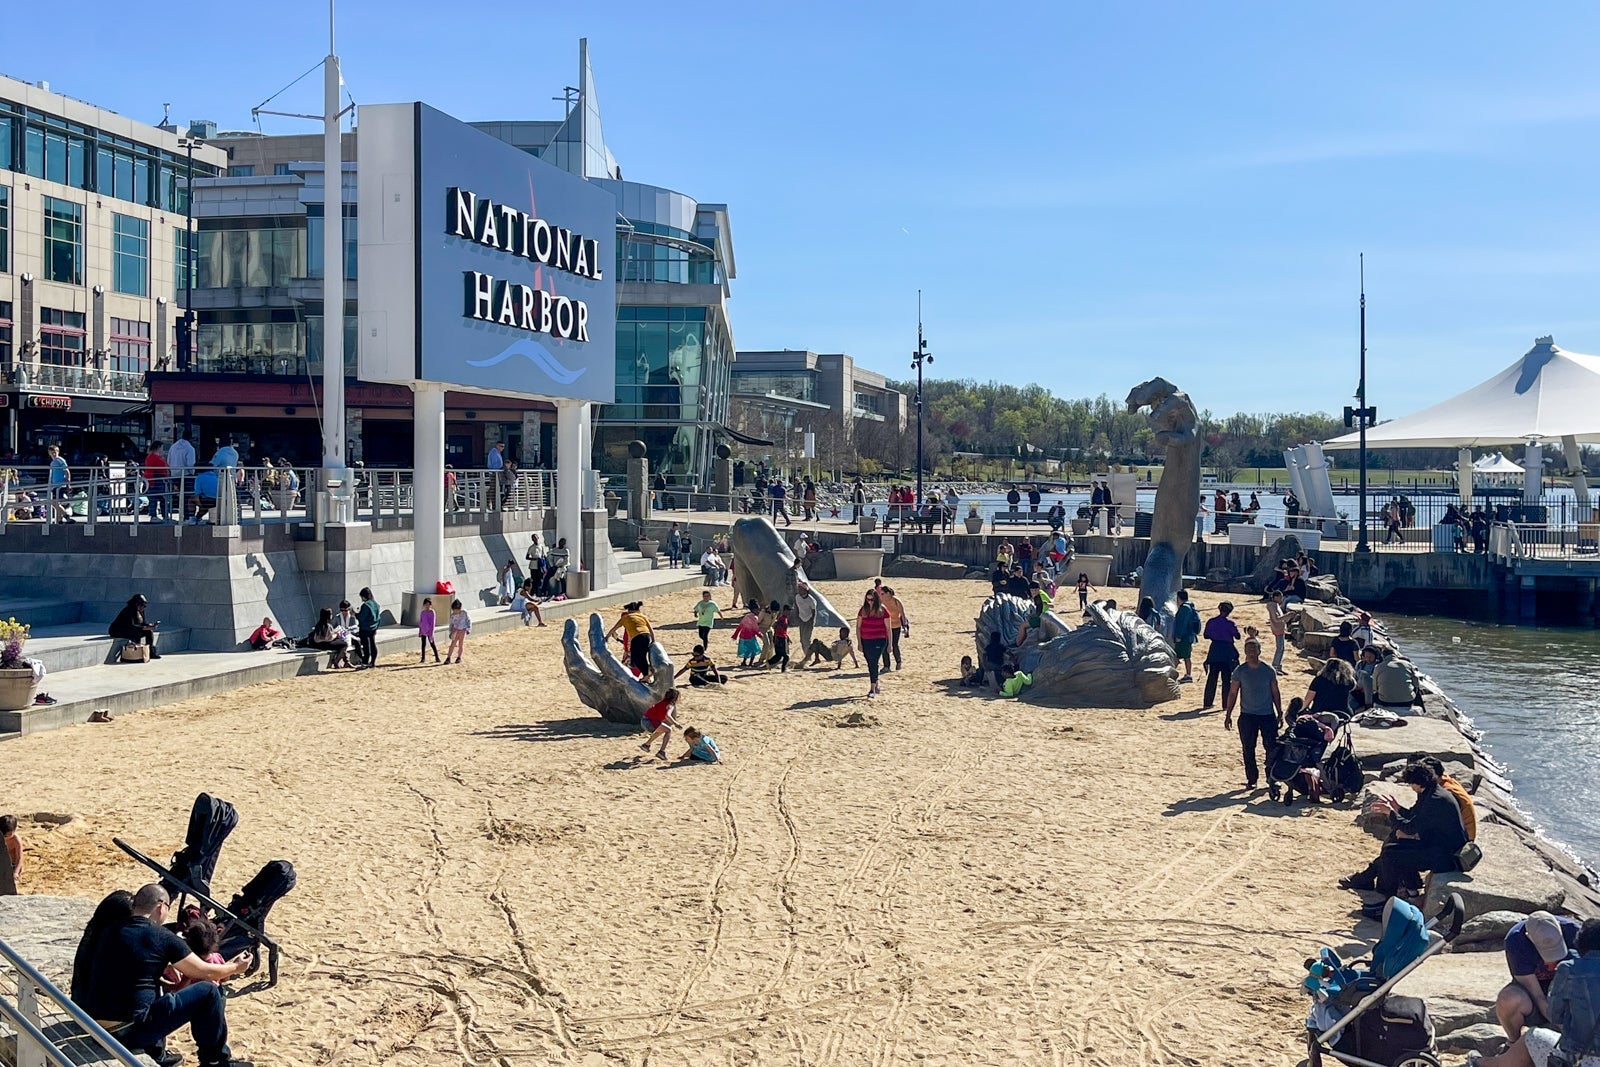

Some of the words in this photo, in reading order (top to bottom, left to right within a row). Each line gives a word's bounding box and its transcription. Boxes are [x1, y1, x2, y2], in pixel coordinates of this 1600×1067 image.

[454, 186, 604, 281] NATIONAL
[472, 270, 590, 343] HARBOR
[41, 397, 72, 407] CHIPOTLE
